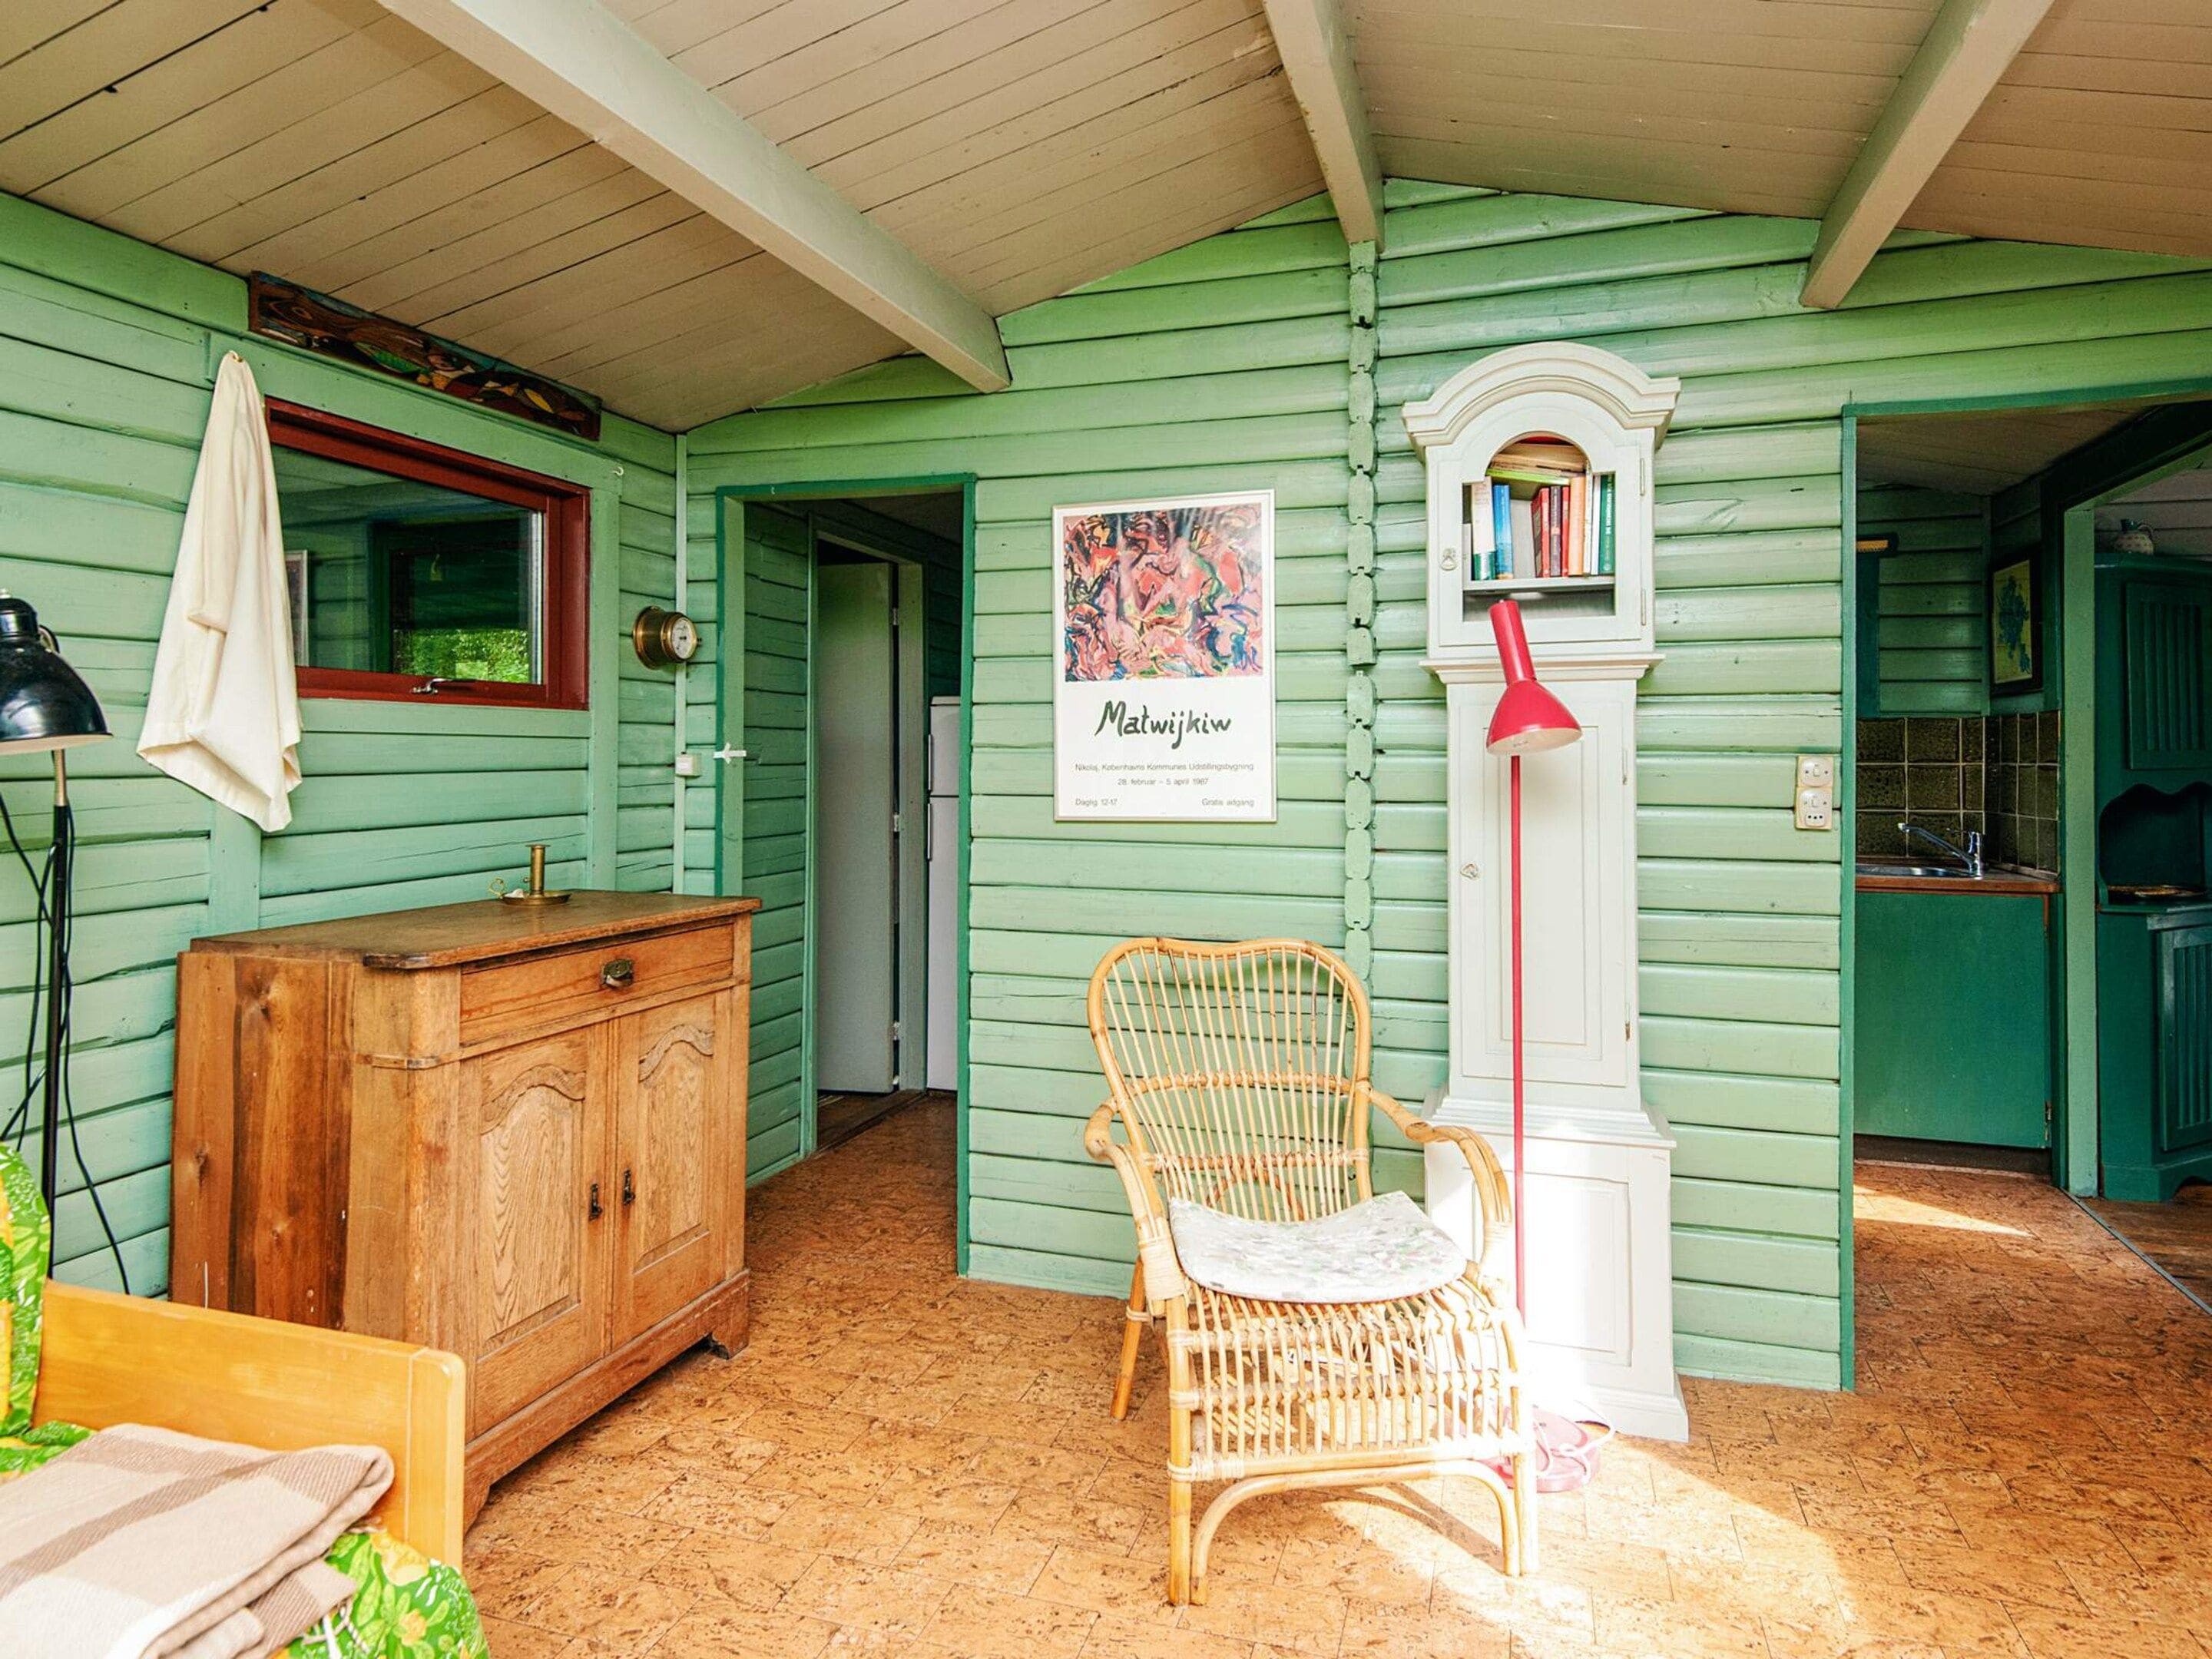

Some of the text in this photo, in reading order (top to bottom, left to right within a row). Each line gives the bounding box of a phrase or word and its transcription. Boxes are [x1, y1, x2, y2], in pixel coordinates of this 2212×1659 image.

[1094, 700, 1231, 750] Matwijkiw
[1147, 763, 1187, 771] Kommunes
[1189, 763, 1254, 772] Udstillingsbygning
[1174, 778, 1189, 786] april
[1075, 798, 1098, 807] Daglig
[1227, 798, 1255, 807] adgang
